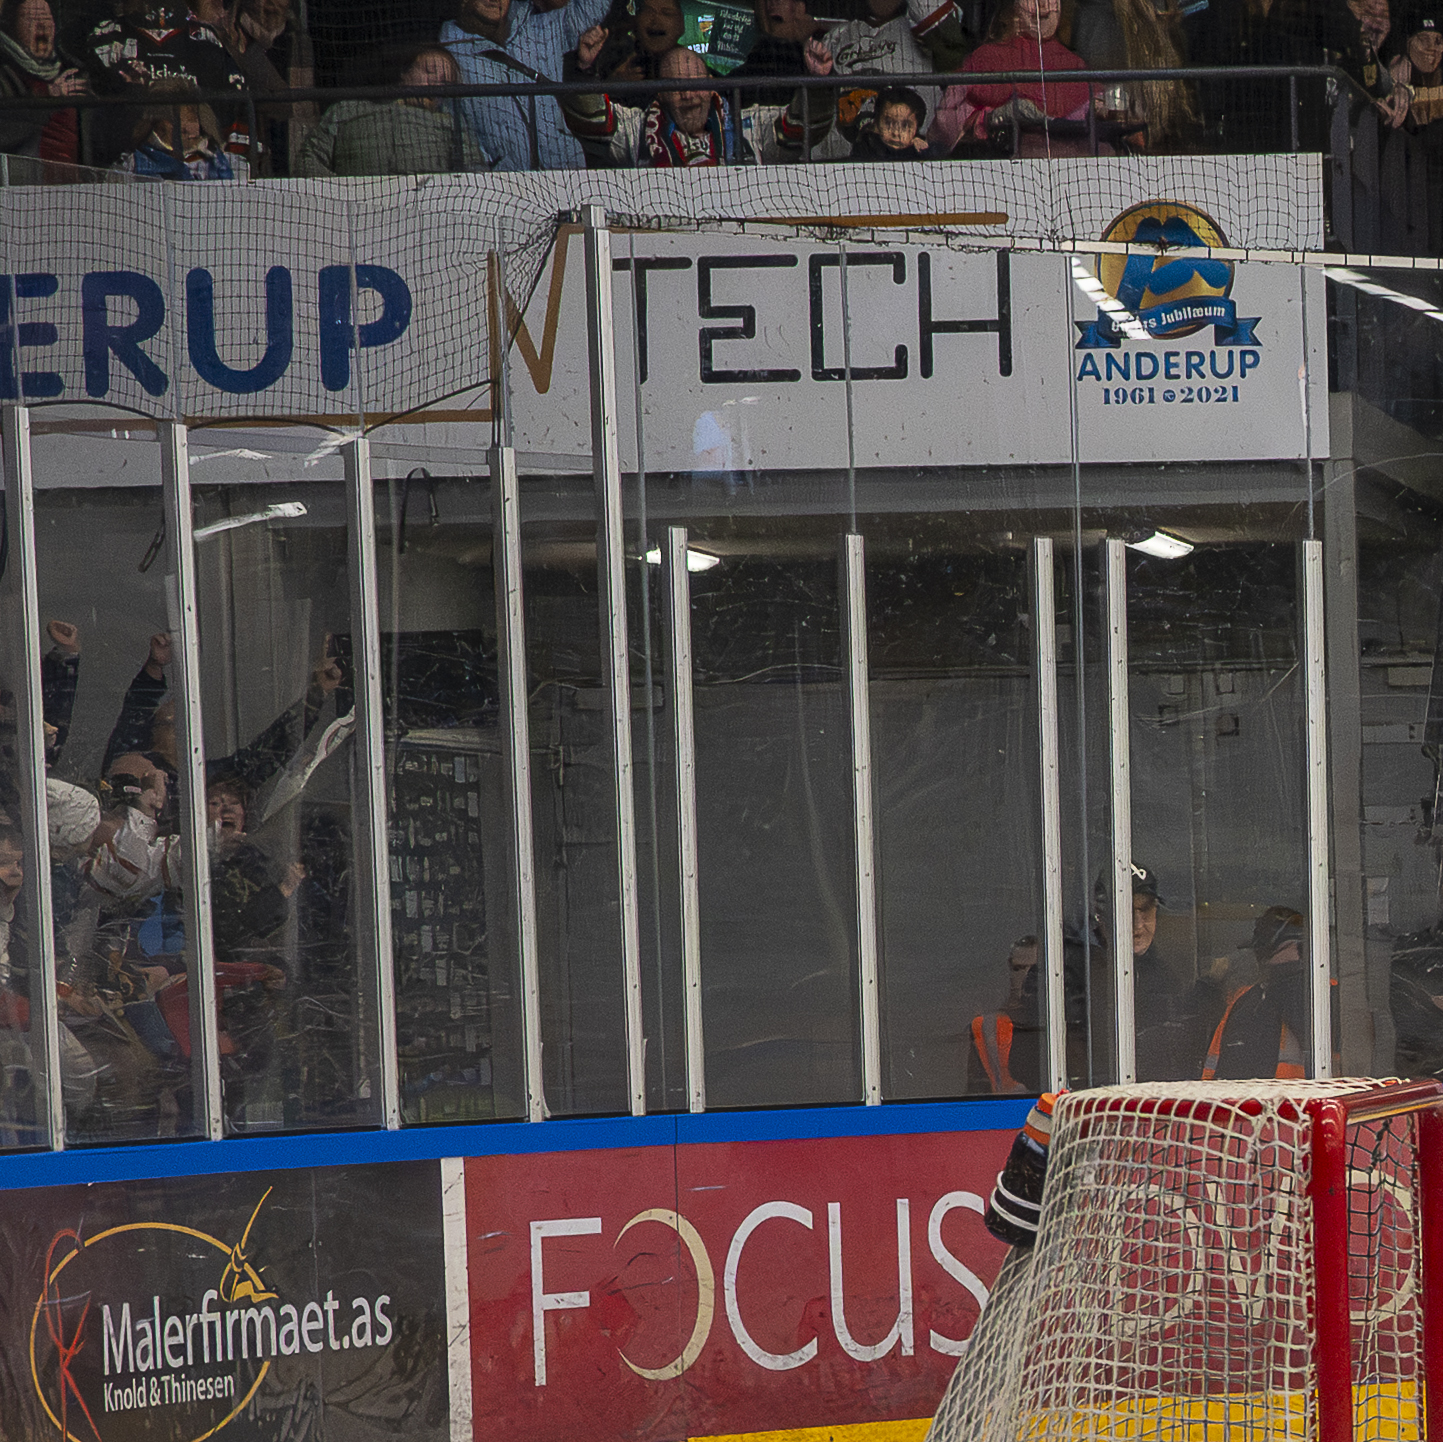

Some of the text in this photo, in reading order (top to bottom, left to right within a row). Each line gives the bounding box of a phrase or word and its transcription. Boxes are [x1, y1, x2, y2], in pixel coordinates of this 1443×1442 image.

[1076, 350, 1261, 382] ANDERUP
[1103, 385, 1240, 405] 1961 2021
[102, 1289, 393, 1376] Malerfirmaet.as
[103, 1376, 148, 1412] Knold
[161, 1373, 236, 1402] Thinesen
